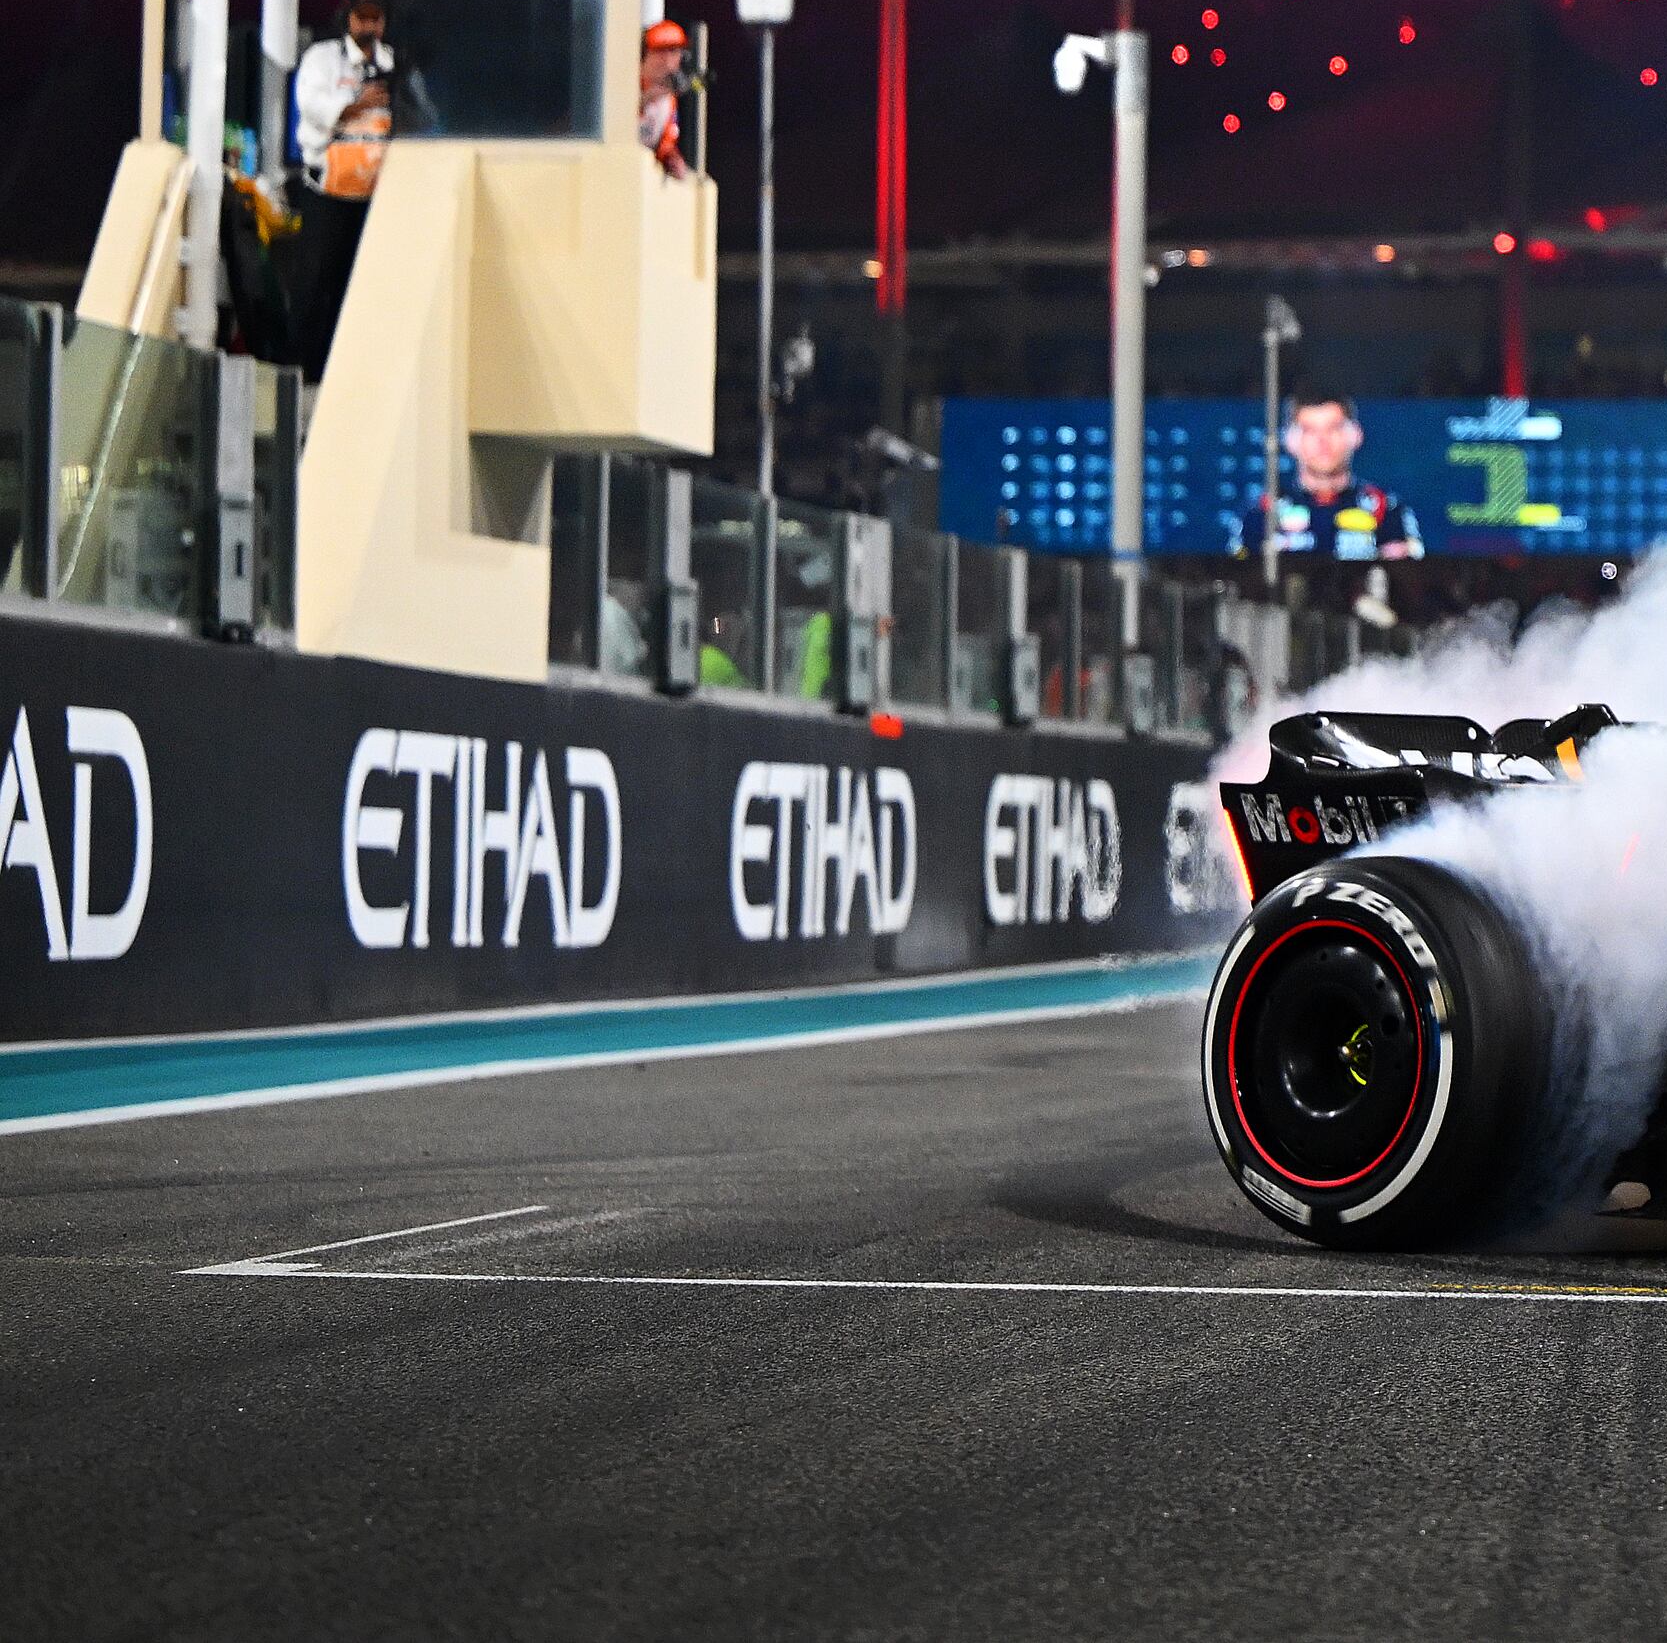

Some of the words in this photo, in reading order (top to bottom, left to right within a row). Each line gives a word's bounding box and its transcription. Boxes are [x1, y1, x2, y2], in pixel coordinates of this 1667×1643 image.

[342, 727, 623, 949] ETIHAD
[730, 761, 917, 941] ETIHAD
[984, 773, 1123, 926] ETIHAD
[1240, 793, 1380, 844] Mobil
